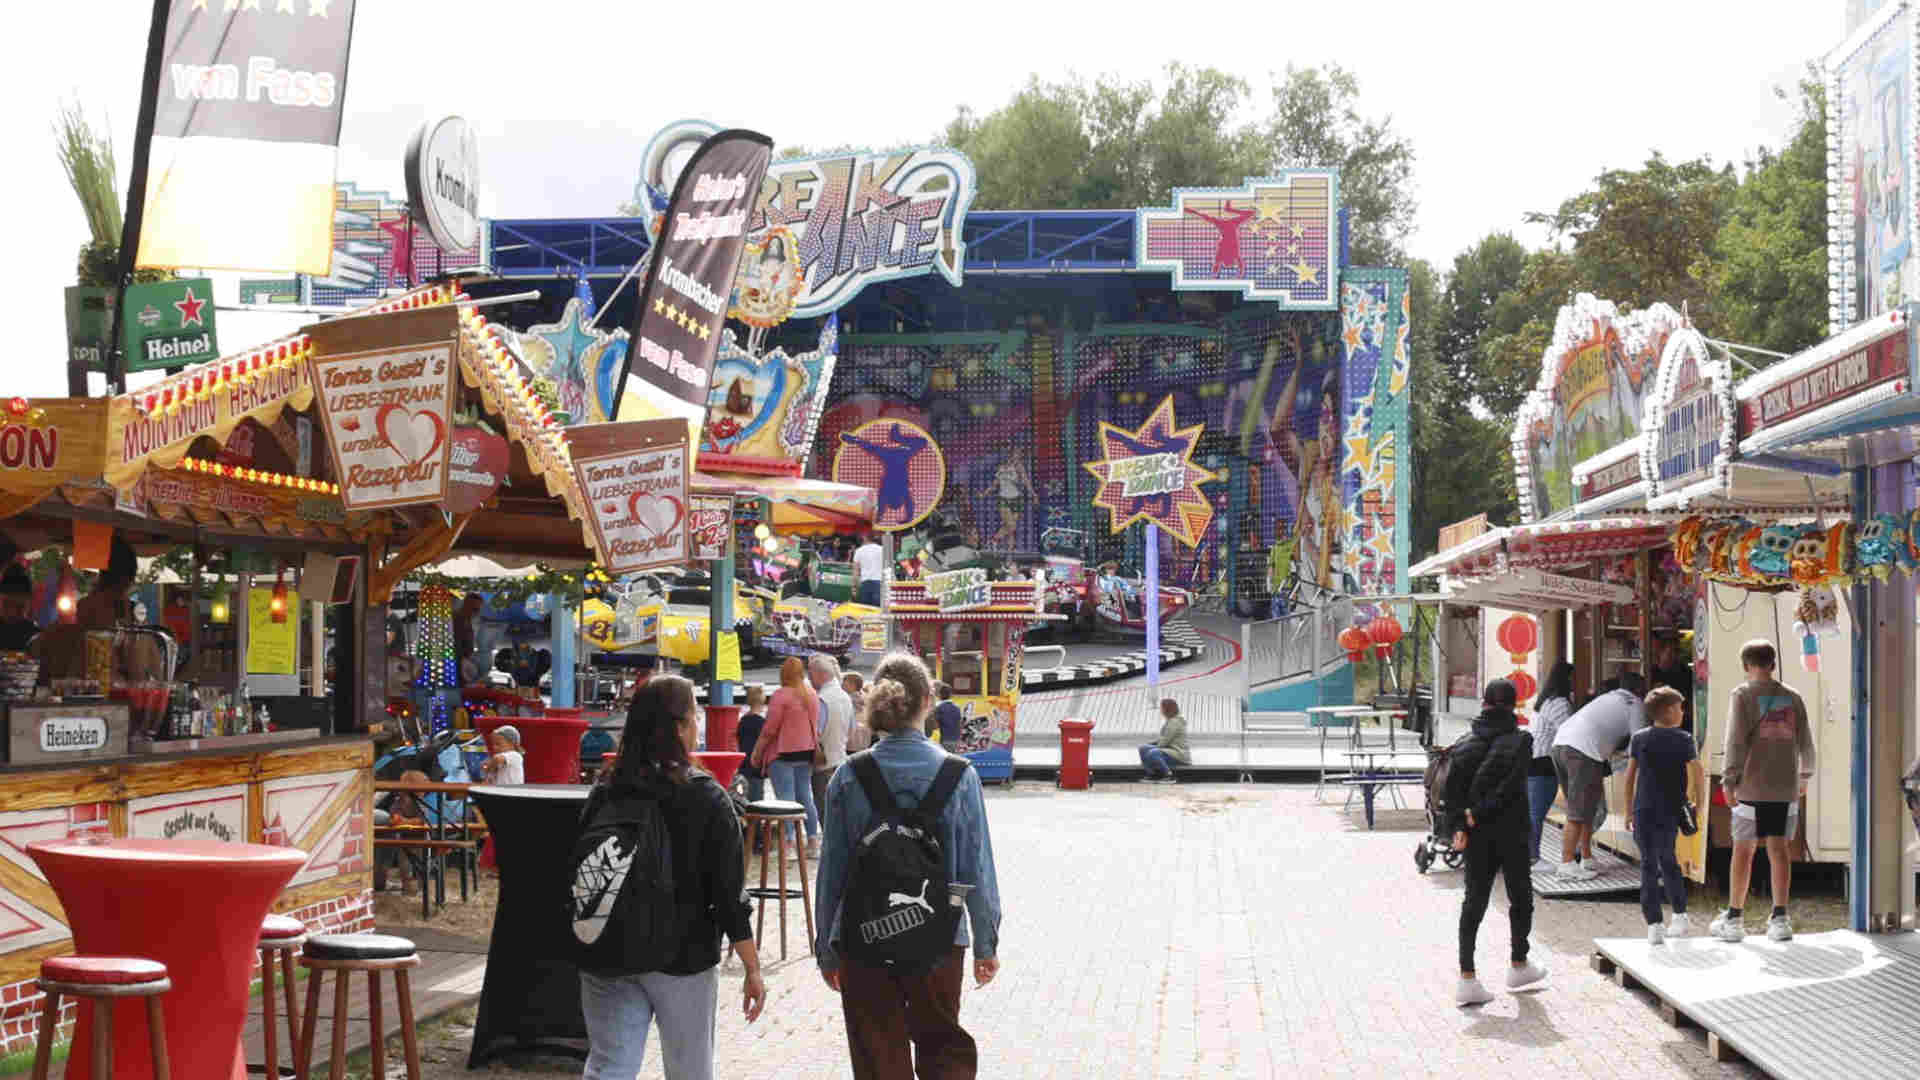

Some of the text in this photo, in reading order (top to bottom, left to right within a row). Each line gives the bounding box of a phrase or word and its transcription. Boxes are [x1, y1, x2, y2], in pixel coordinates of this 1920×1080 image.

[246, 55, 335, 107] Fass
[329, 384, 445, 413] LIEBESTRANK
[123, 410, 169, 464] MOIN
[344, 462, 441, 495] Rezeptur
[46, 723, 99, 748] Heineken
[860, 903, 926, 944] PUMA
